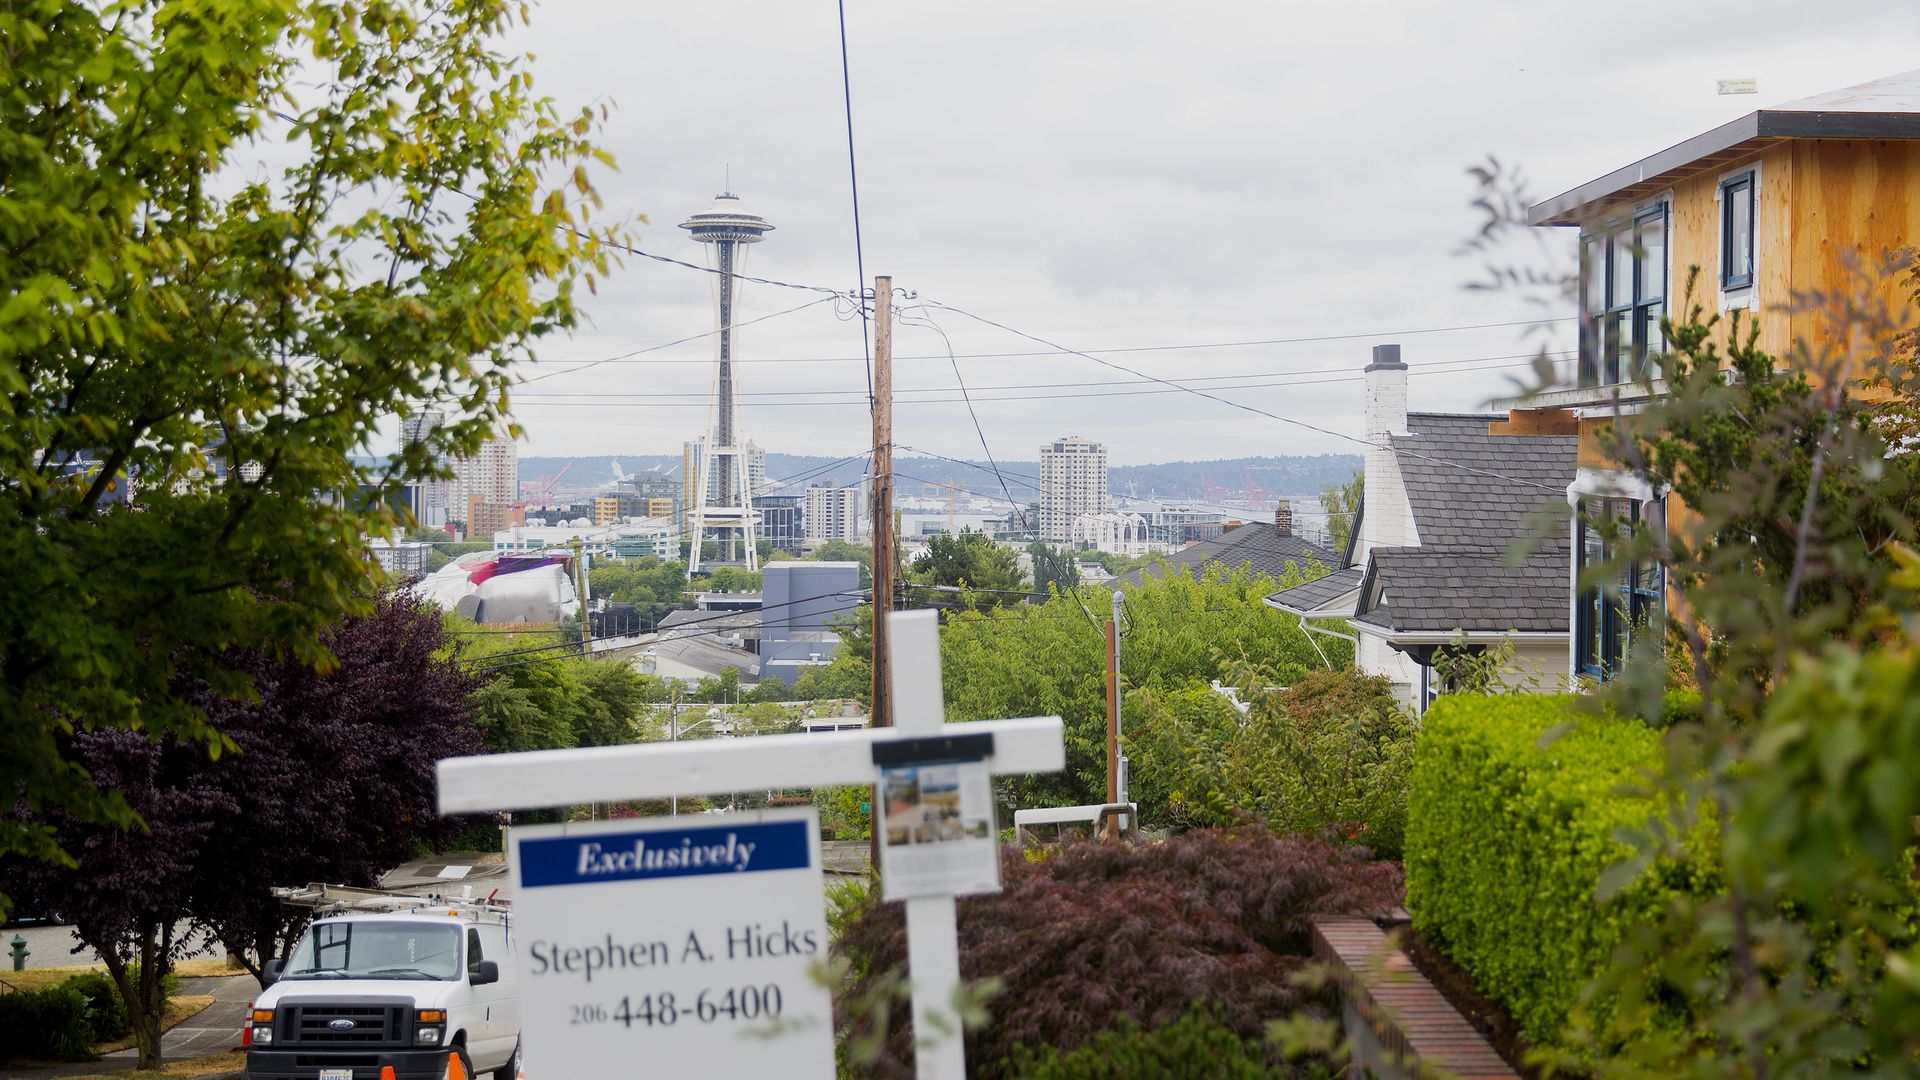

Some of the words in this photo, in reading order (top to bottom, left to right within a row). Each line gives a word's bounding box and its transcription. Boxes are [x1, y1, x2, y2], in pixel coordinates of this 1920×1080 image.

[576, 833, 756, 875] Exclusively
[530, 933, 669, 983] Stephen
[681, 930, 714, 963] A.
[726, 920, 818, 960] Hicks
[570, 1004, 608, 1026] 206
[613, 983, 783, 1028] 448-6400
